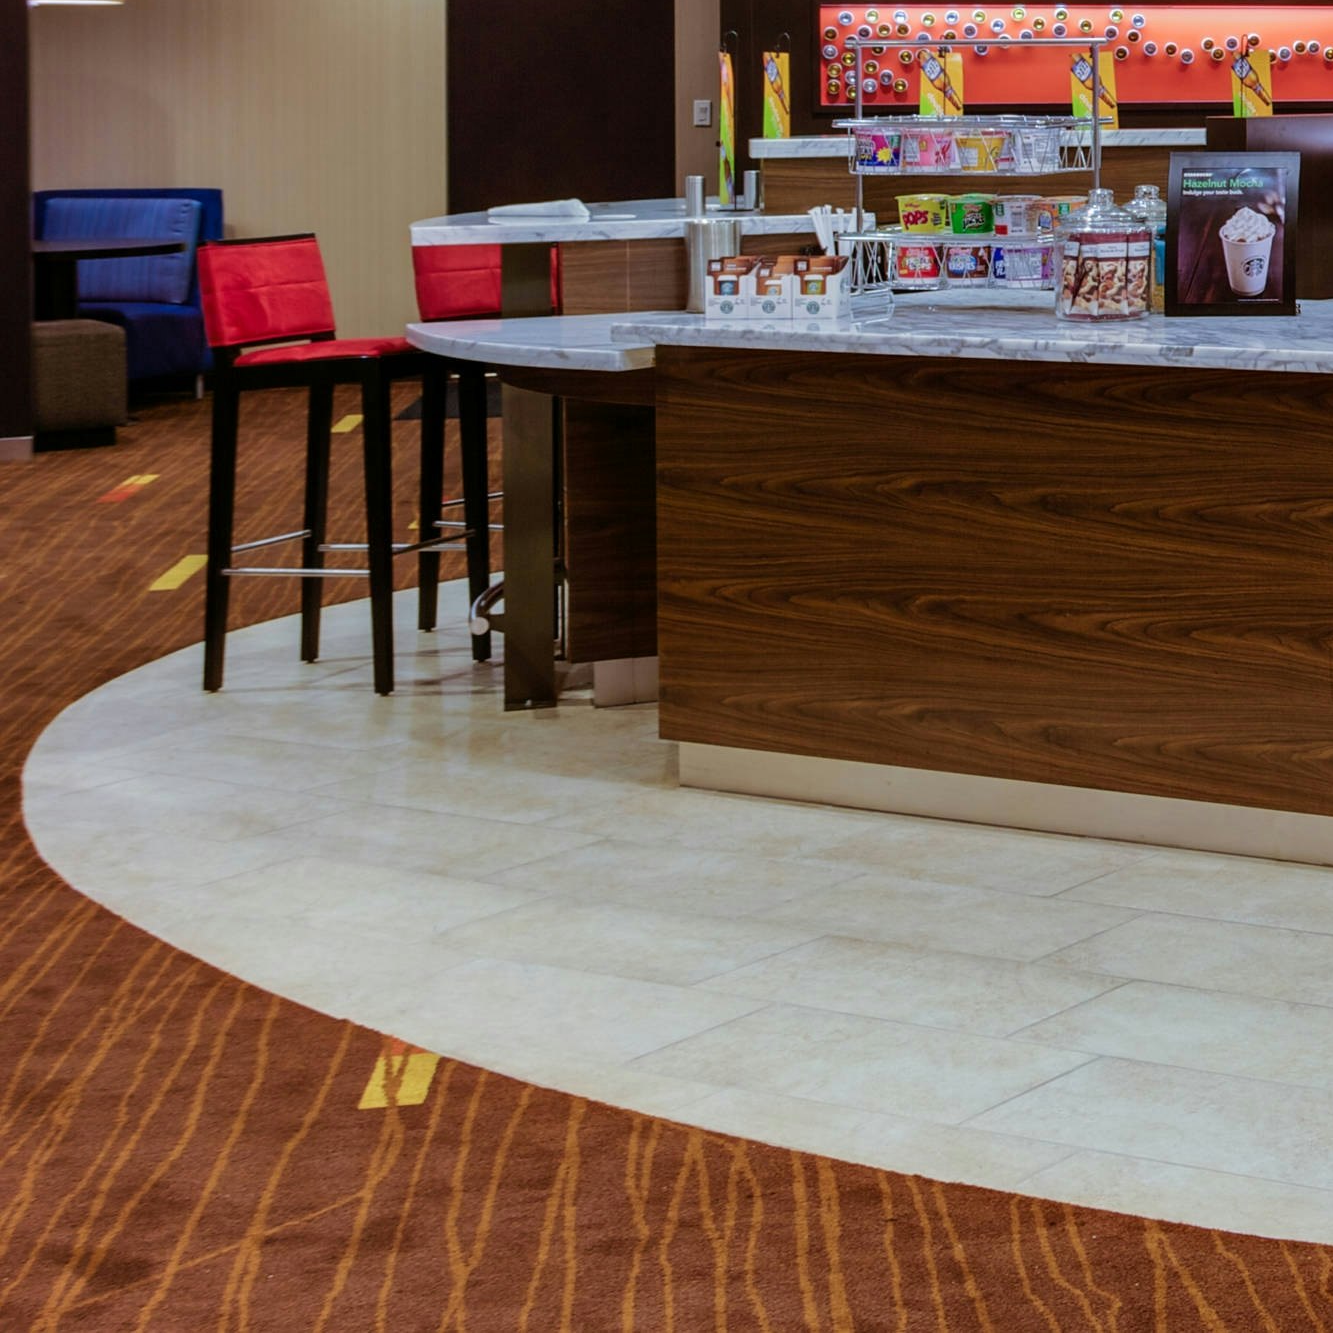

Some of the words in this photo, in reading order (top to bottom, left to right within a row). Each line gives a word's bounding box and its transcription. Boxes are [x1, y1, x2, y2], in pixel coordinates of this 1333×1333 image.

[1183, 178, 1227, 188] Hazelnut
[1229, 178, 1264, 188] Mocha
[902, 210, 929, 230] POPS
